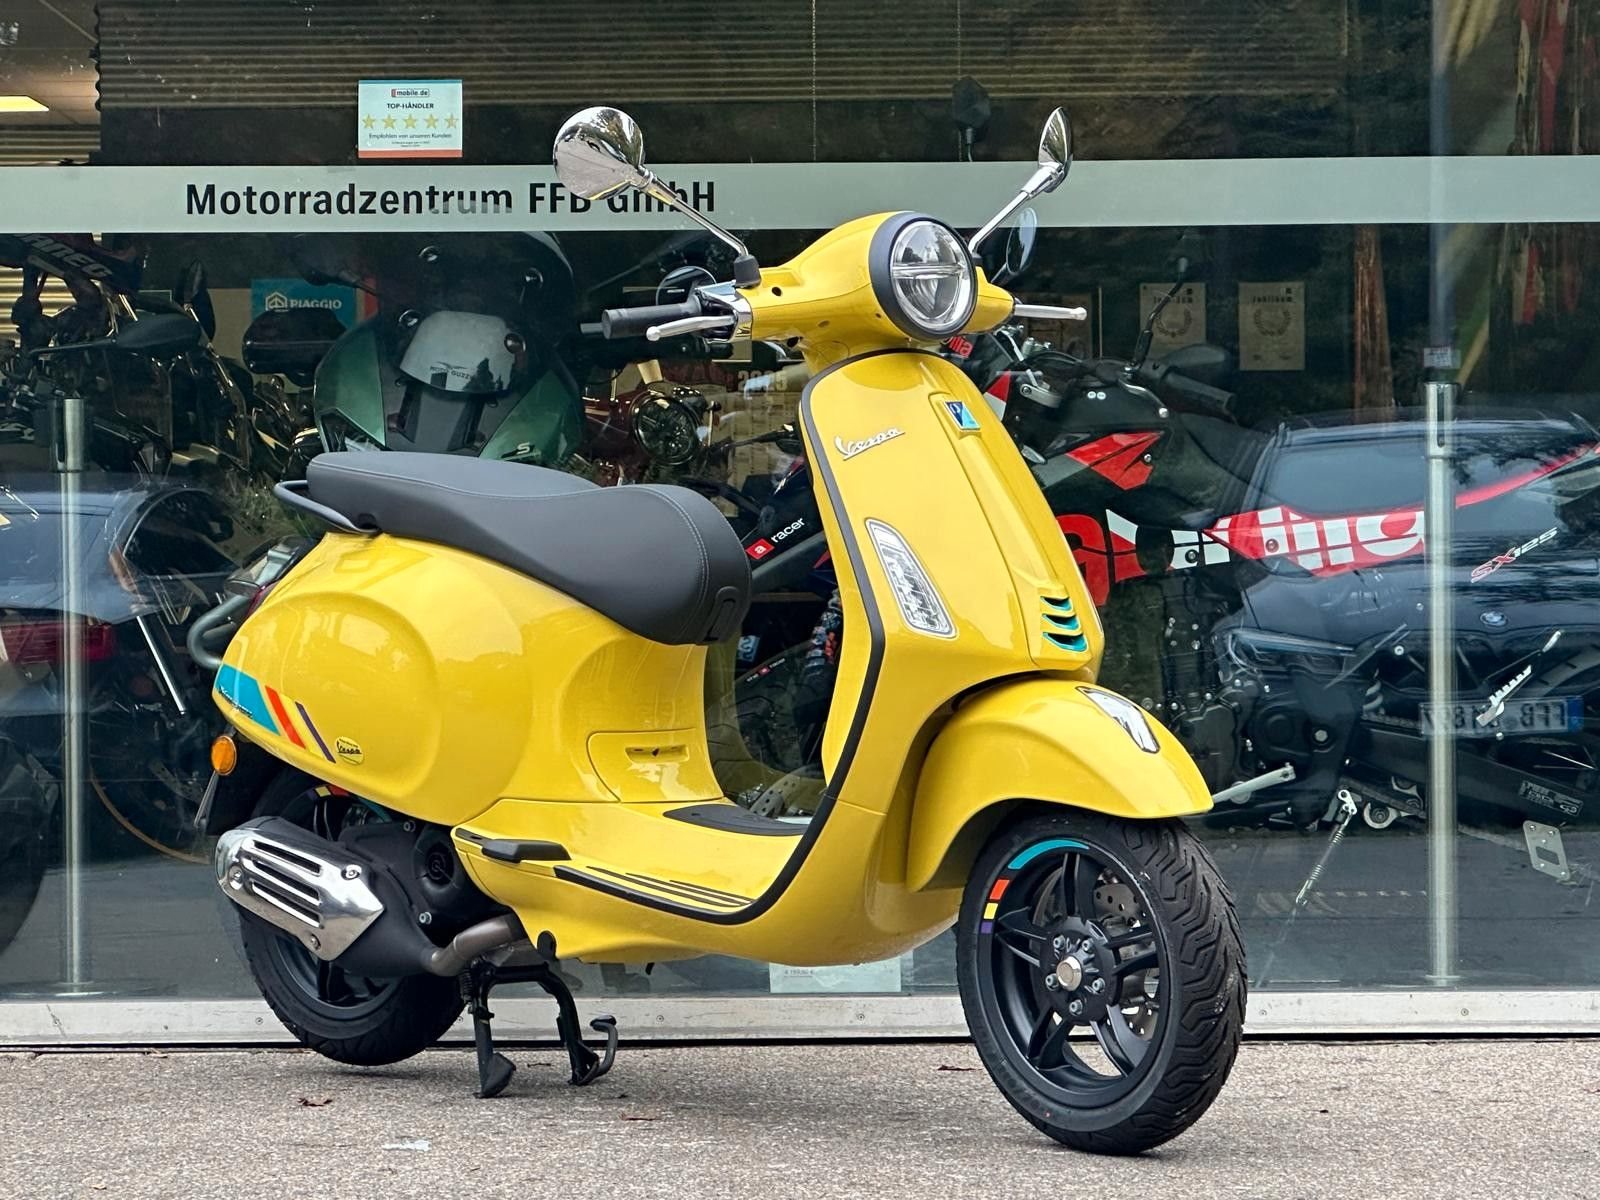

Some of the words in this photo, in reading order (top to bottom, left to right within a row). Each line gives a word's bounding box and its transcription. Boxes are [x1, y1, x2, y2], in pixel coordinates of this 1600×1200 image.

[186, 183, 512, 215] Motorradzentrum
[290, 299, 343, 310] PIAGGIO
[834, 427, 906, 461] Vespa
[770, 517, 805, 543] racer
